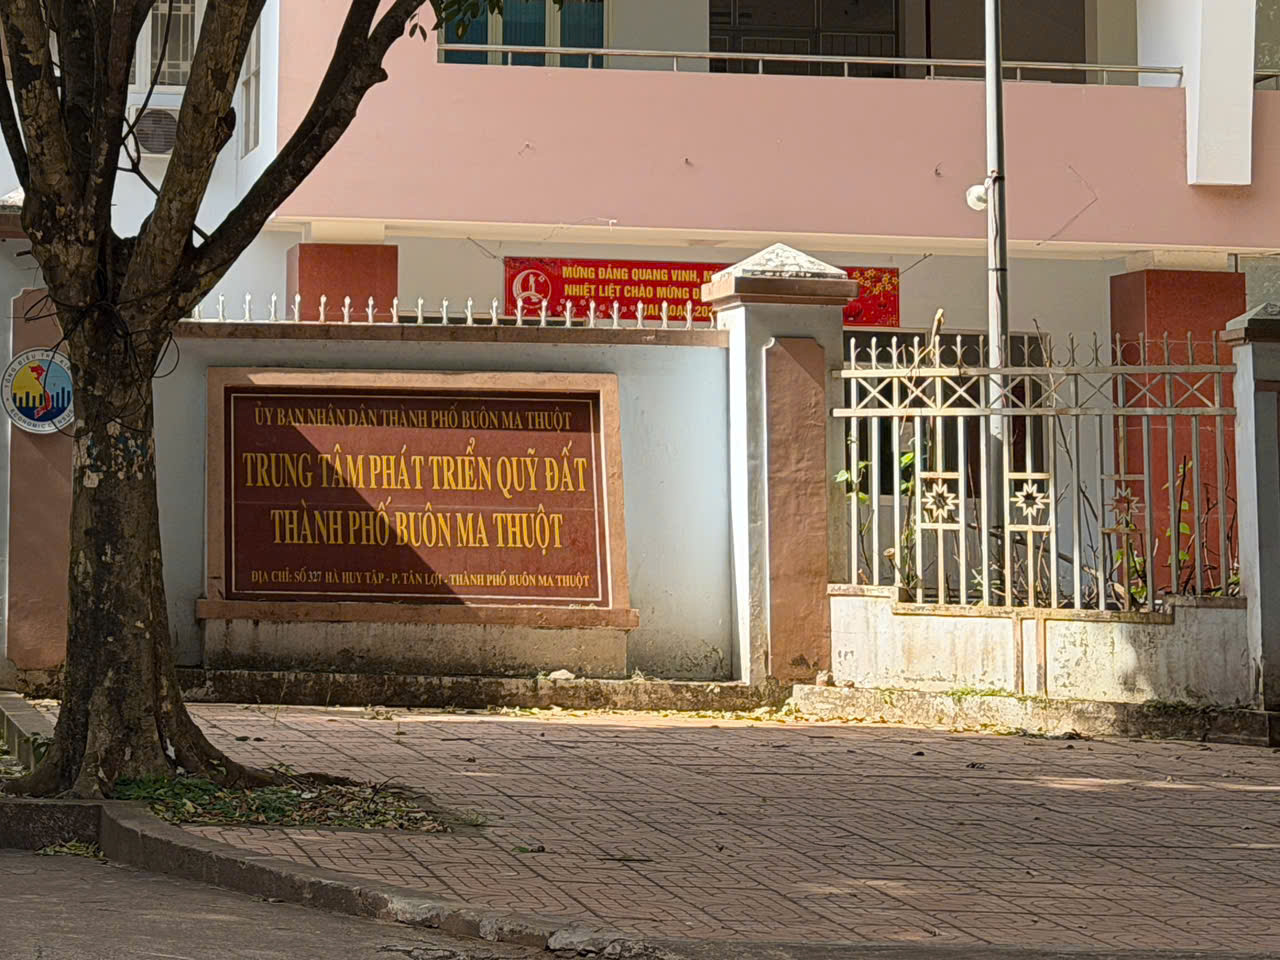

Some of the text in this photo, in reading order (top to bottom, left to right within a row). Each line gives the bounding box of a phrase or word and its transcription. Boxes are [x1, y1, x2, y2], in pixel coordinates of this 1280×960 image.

[598, 264, 628, 280] ĐẢNG
[631, 268, 668, 281] QUANG
[671, 269, 700, 283] VINH,
[564, 282, 596, 299] NHIỆT
[599, 283, 621, 299] LIỆT
[624, 283, 654, 298] CHÀO
[255, 401, 571, 433] ỦY BAN NHÂN DÂN THÀNH PHỐ BUÔN MA THUỘT
[242, 437, 587, 499] TRUNG TÂM PHÁT TRIỂN QUỸ ĐẤT
[270, 496, 563, 556] THÀNH PHỐ BUÔN MA THUỘT
[251, 570, 269, 584] ĐỊA
[294, 566, 307, 583] SỐ
[307, 570, 321, 583] 327
[325, 568, 339, 583] HÀ
[342, 571, 362, 584] HUY
[365, 569, 384, 585] TẬP
[402, 570, 423, 585] TÂN
[449, 571, 484, 586] THÀNH
[486, 569, 506, 586] PHỐ
[509, 571, 536, 586] BUÔN
[538, 575, 554, 587] MA
[556, 572, 590, 589] THUỘT
